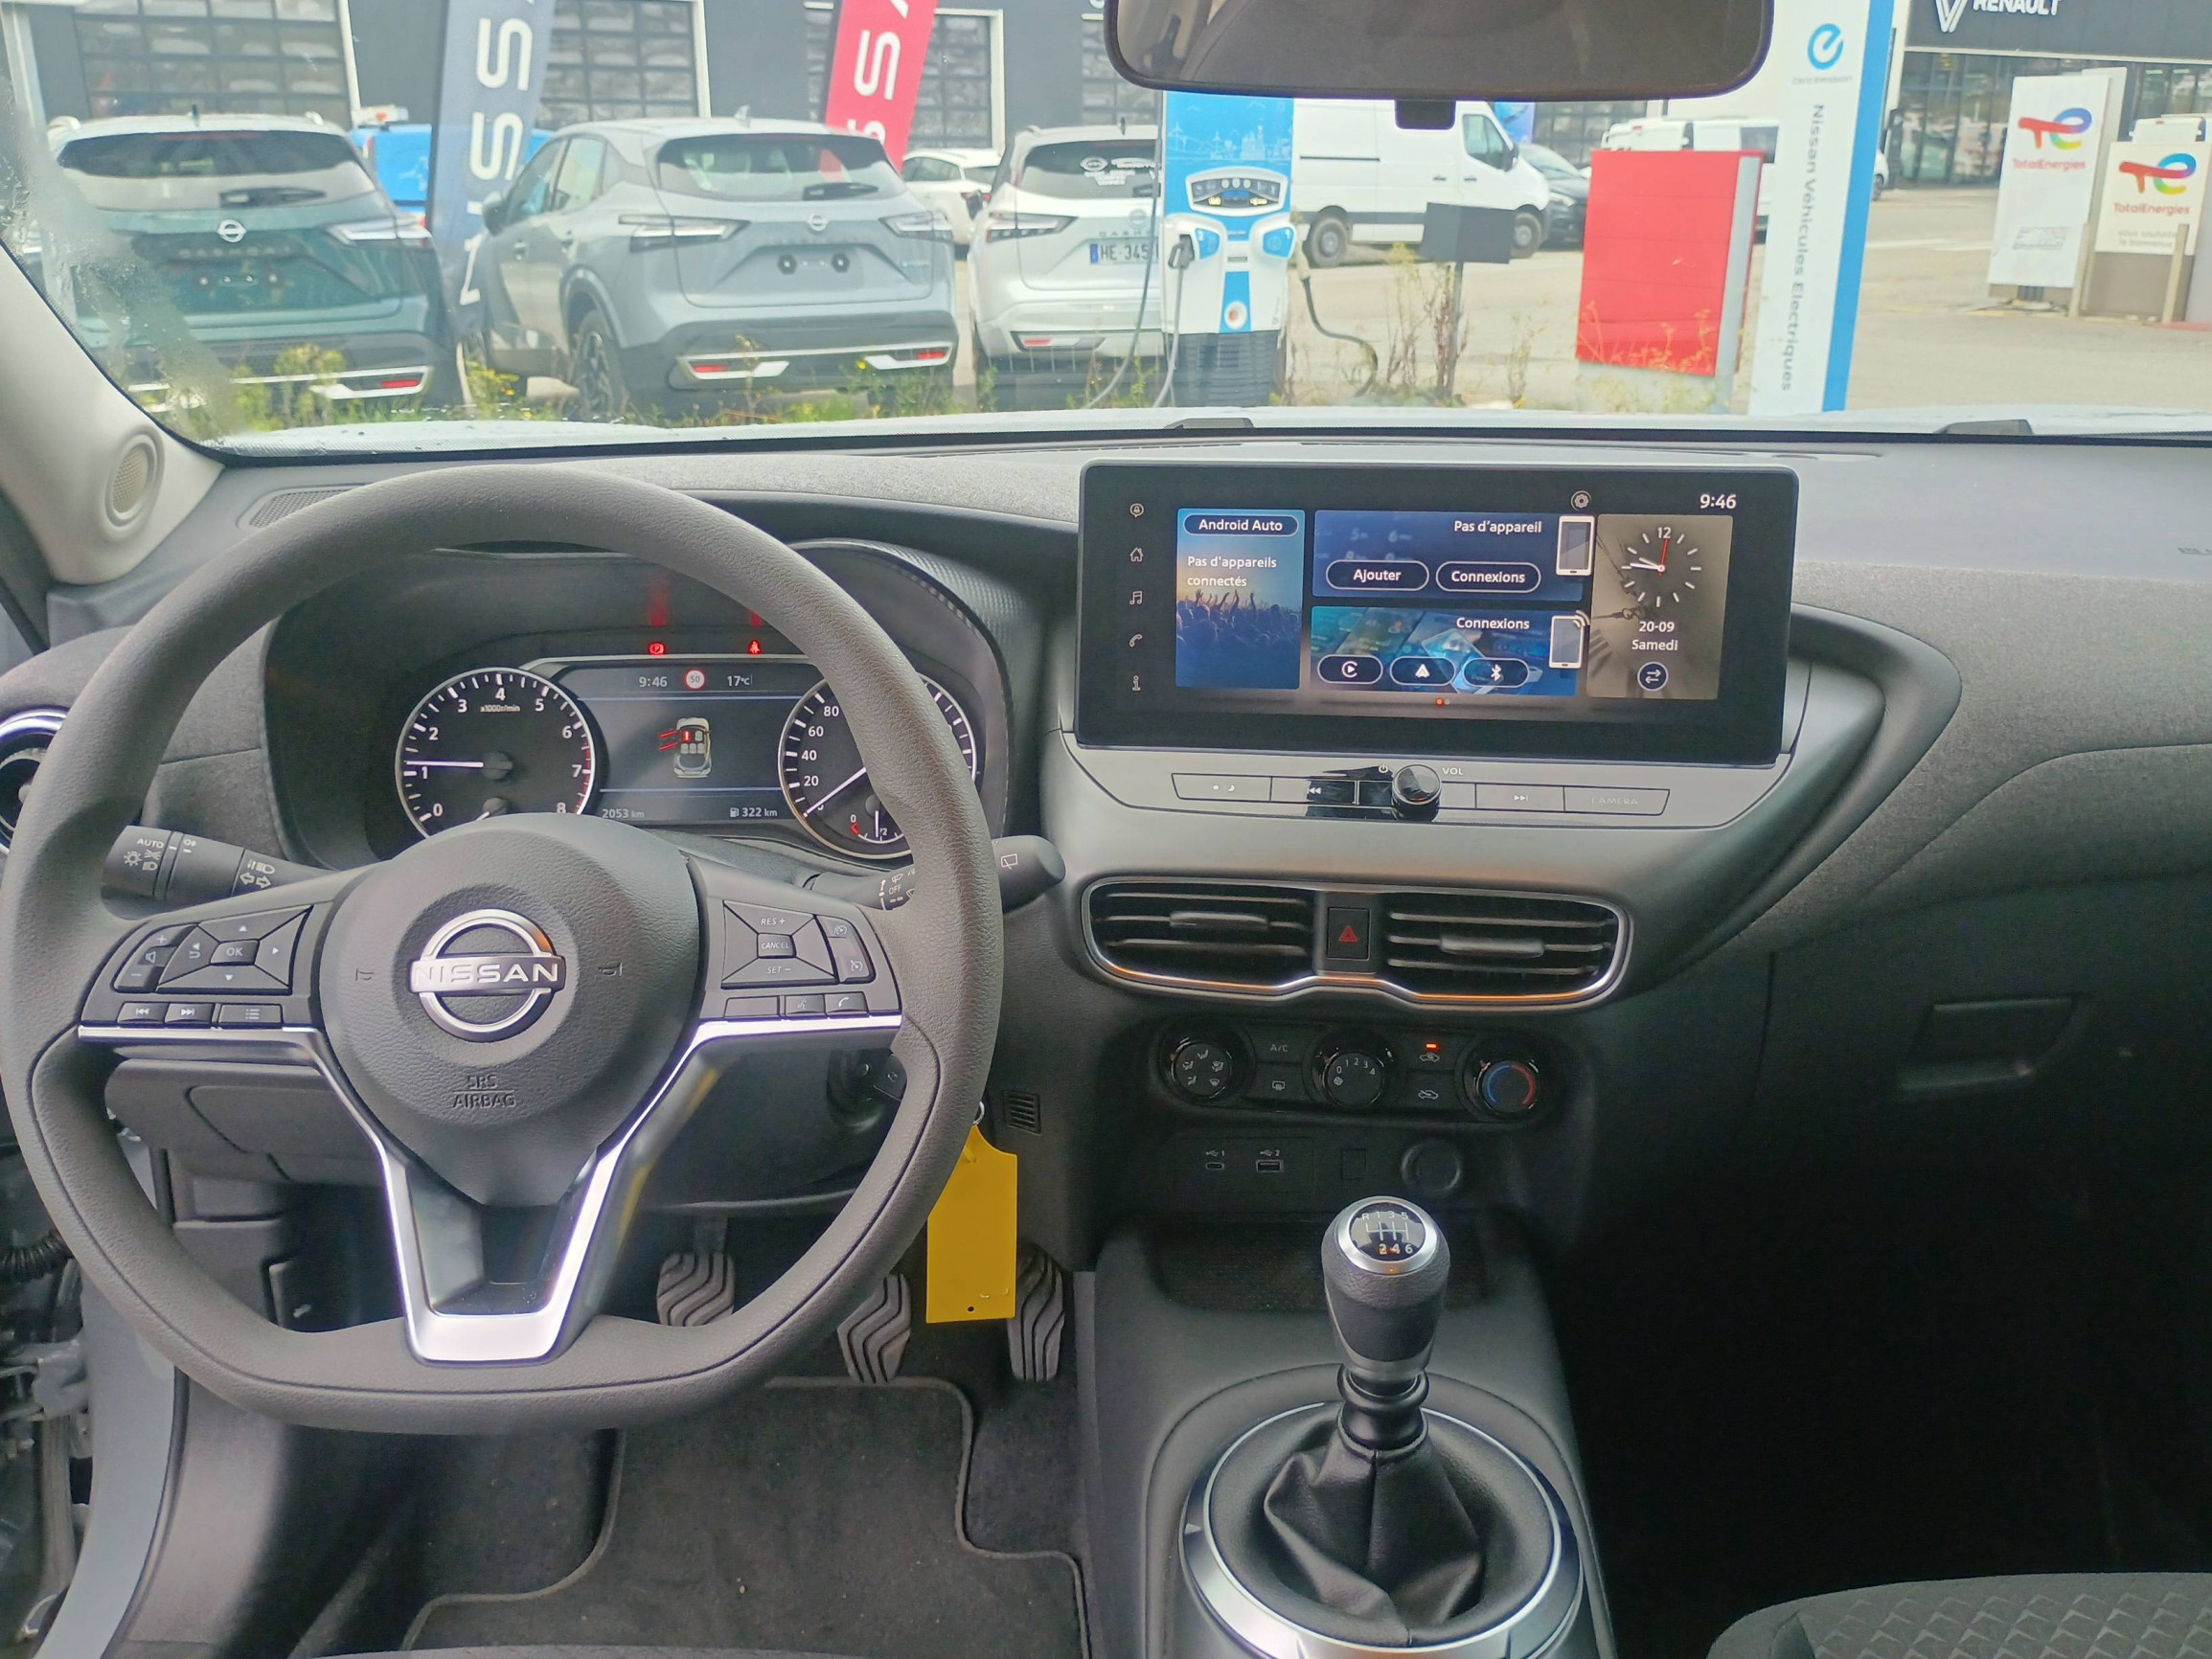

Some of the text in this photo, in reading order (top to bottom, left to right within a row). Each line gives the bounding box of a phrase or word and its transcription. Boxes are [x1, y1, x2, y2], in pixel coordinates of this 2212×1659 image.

[1806, 104, 1824, 174] Nissan
[2012, 158, 2087, 172] TotalEnergies
[2113, 202, 2190, 216] TotalEnergies
[1699, 493, 1737, 510] 9:46
[1198, 518, 1284, 532] Android Auto
[1453, 520, 1476, 533] Pas
[1656, 526, 1673, 539] 12
[1187, 556, 1277, 570] Pas d'appareils
[1187, 574, 1247, 587] connectés
[1353, 568, 1402, 582] Ajouter
[1451, 570, 1525, 583] Connexions
[1456, 617, 1530, 630] Connexions
[1638, 621, 1675, 633] 20-09
[1631, 639, 1678, 651] Samedi
[638, 675, 668, 688] 9:46
[690, 675, 700, 684] 50
[495, 688, 506, 701] 4
[458, 699, 467, 713] 3
[535, 698, 545, 712] 5
[823, 705, 839, 717] 80
[428, 727, 439, 740] 2
[562, 725, 572, 739] 6
[808, 725, 824, 738] 60
[801, 749, 817, 761] 40
[422, 766, 428, 780] 1
[572, 764, 582, 778] 7
[1442, 767, 1464, 776] VOL
[803, 775, 819, 786] 20
[1591, 797, 1638, 806] CAMERA
[432, 803, 444, 817] 0
[556, 802, 566, 814] 8
[602, 808, 645, 818] 2053 km
[741, 807, 778, 817] 322 km
[850, 814, 857, 823] 0
[136, 838, 165, 850] AUTO
[888, 884, 902, 895] OFF
[760, 917, 777, 926] RES
[226, 946, 243, 957] OK
[761, 941, 789, 950] CANCEL
[414, 963, 559, 987] NISSAN
[766, 966, 782, 974] SET
[1269, 1043, 1288, 1054] A/C
[1354, 1057, 1359, 1066] 2
[1363, 1060, 1369, 1069] 3
[1335, 1065, 1342, 1074] 0
[1369, 1067, 1376, 1076] 4
[467, 1073, 498, 1090] SRS
[452, 1093, 517, 1109] AIRBAG
[1361, 1212, 1370, 1221] R
[1387, 1210, 1396, 1219] 3
[1401, 1211, 1409, 1220] 5
[1379, 1243, 1413, 1255] 2 4 6
